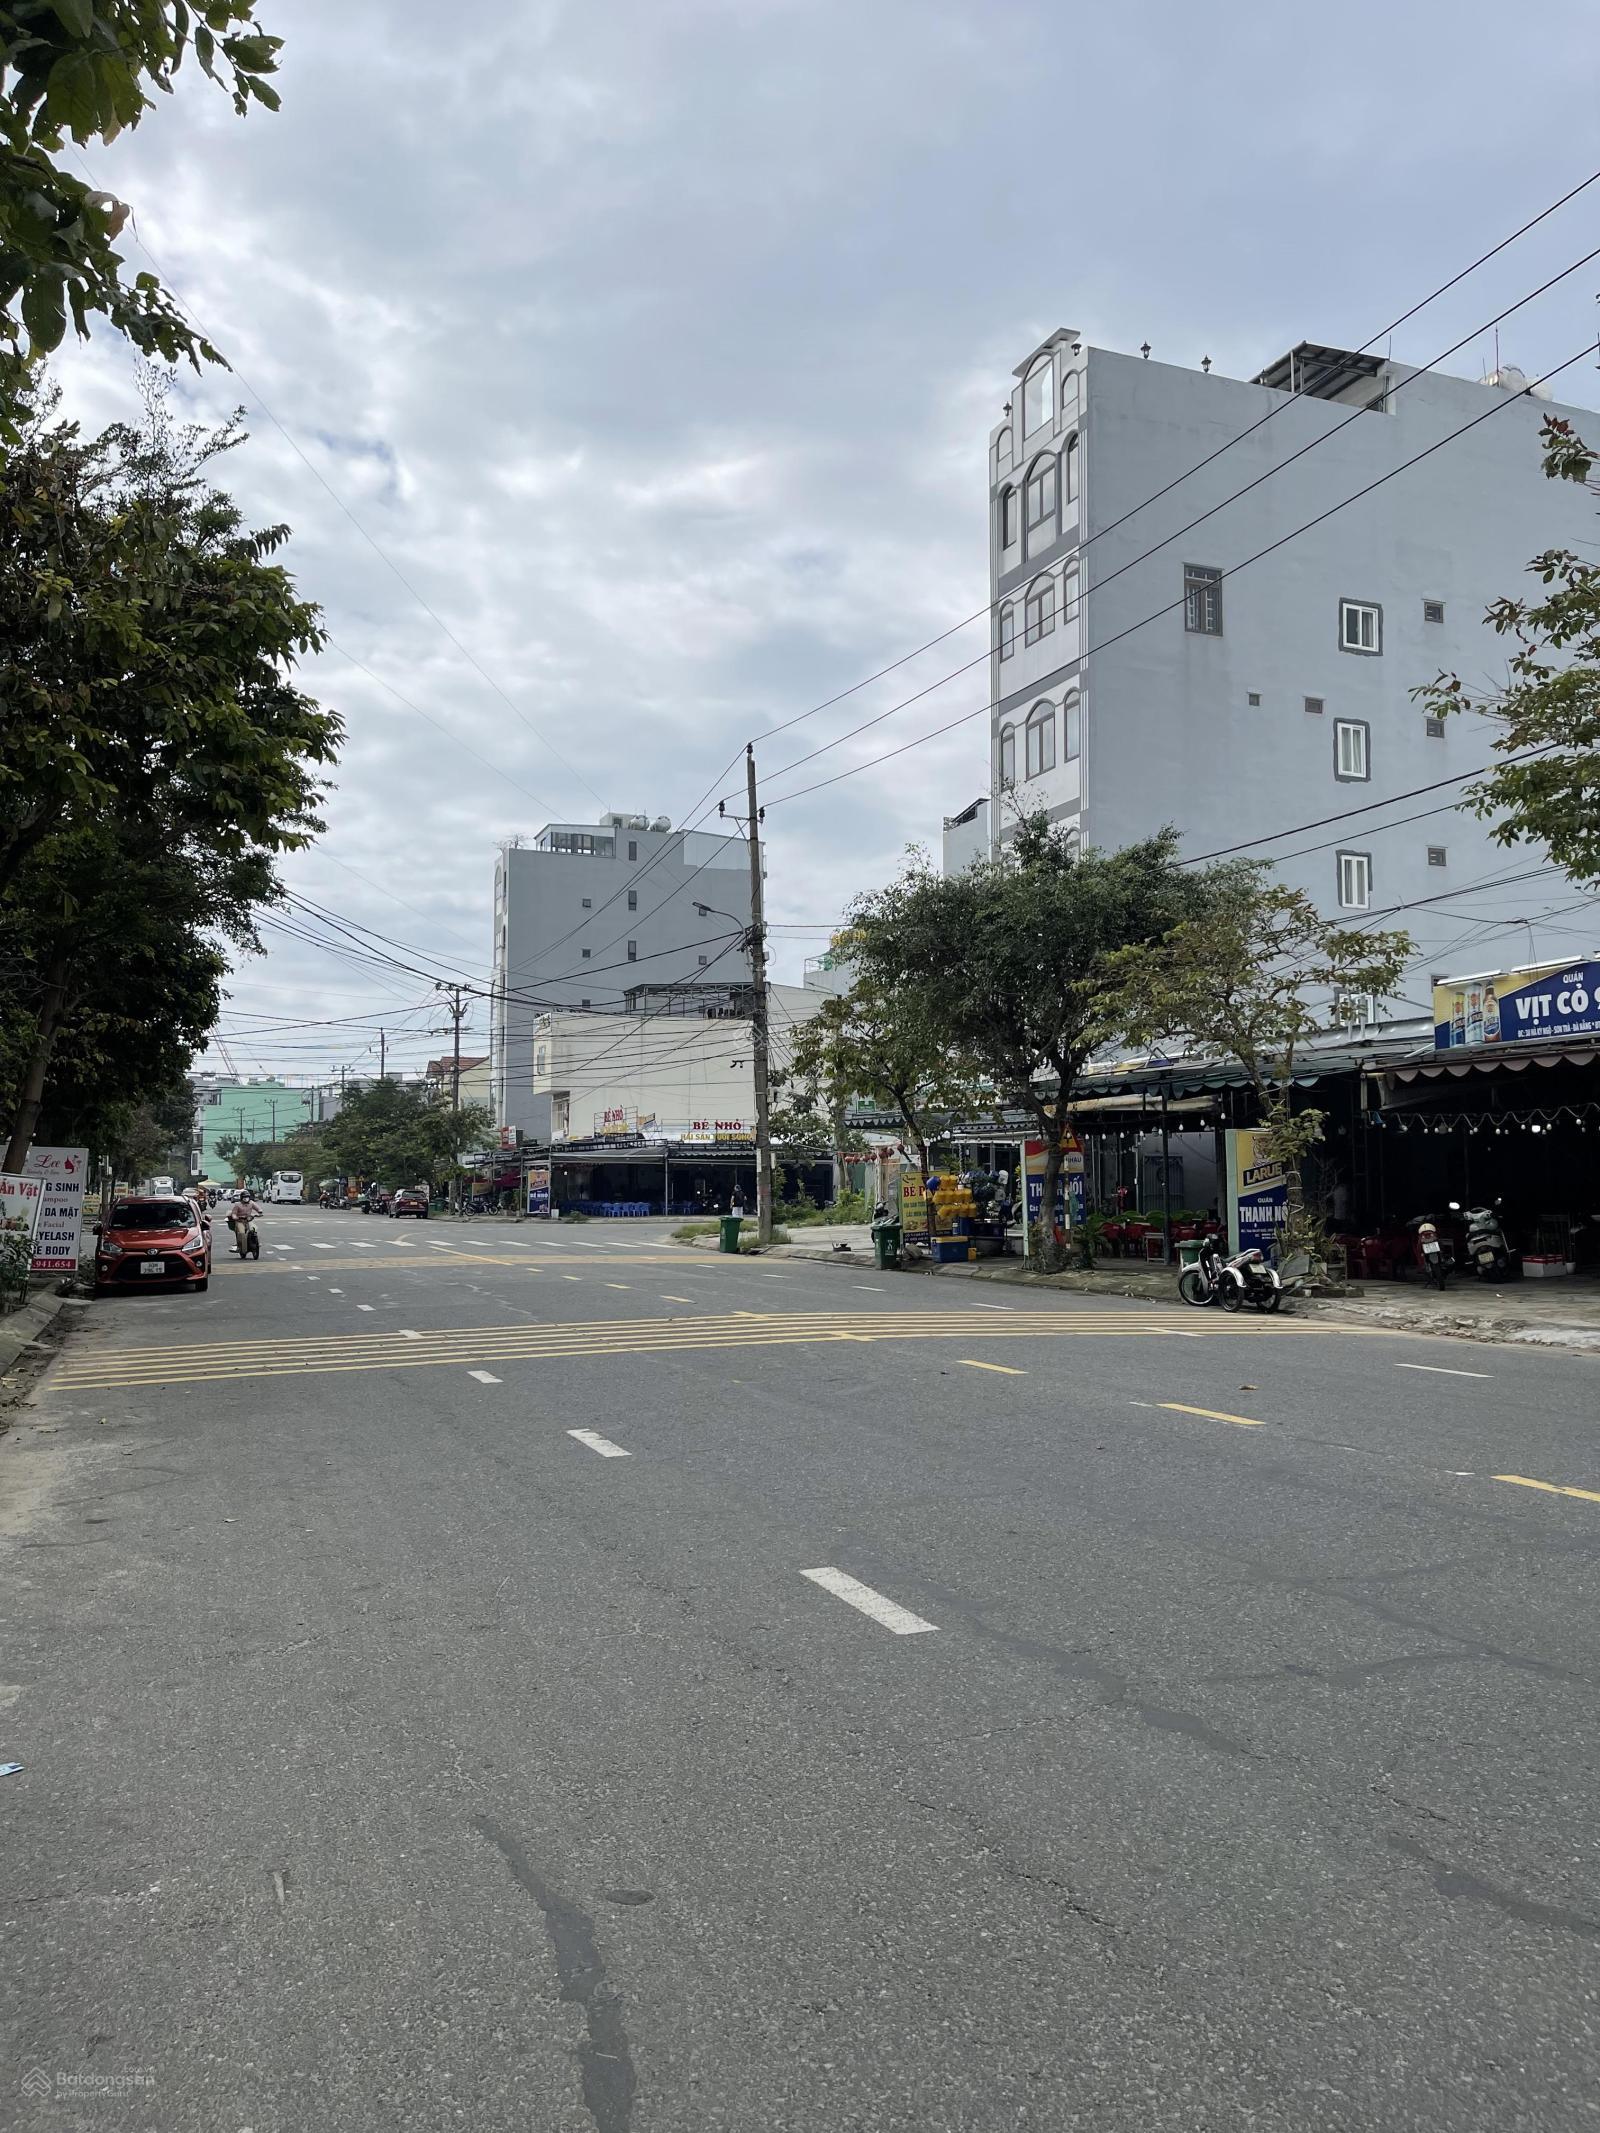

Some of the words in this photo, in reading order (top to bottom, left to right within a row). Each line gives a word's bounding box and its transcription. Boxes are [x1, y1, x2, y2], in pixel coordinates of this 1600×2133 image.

[1563, 971, 1584, 984] QUÁN
[1515, 994, 1552, 1025] VỊT
[1557, 983, 1589, 1014] CỎ
[693, 1118, 709, 1130] BÉ
[715, 1118, 742, 1130] NHỎ
[1246, 1163, 1283, 1184] LARUE
[19, 1181, 39, 1200] Vặt
[55, 1183, 79, 1192] SINH
[45, 1208, 56, 1217] DA
[60, 1206, 79, 1219] MẶT
[1240, 1206, 1273, 1228] THẠNH
[46, 1246, 71, 1255] BODY
